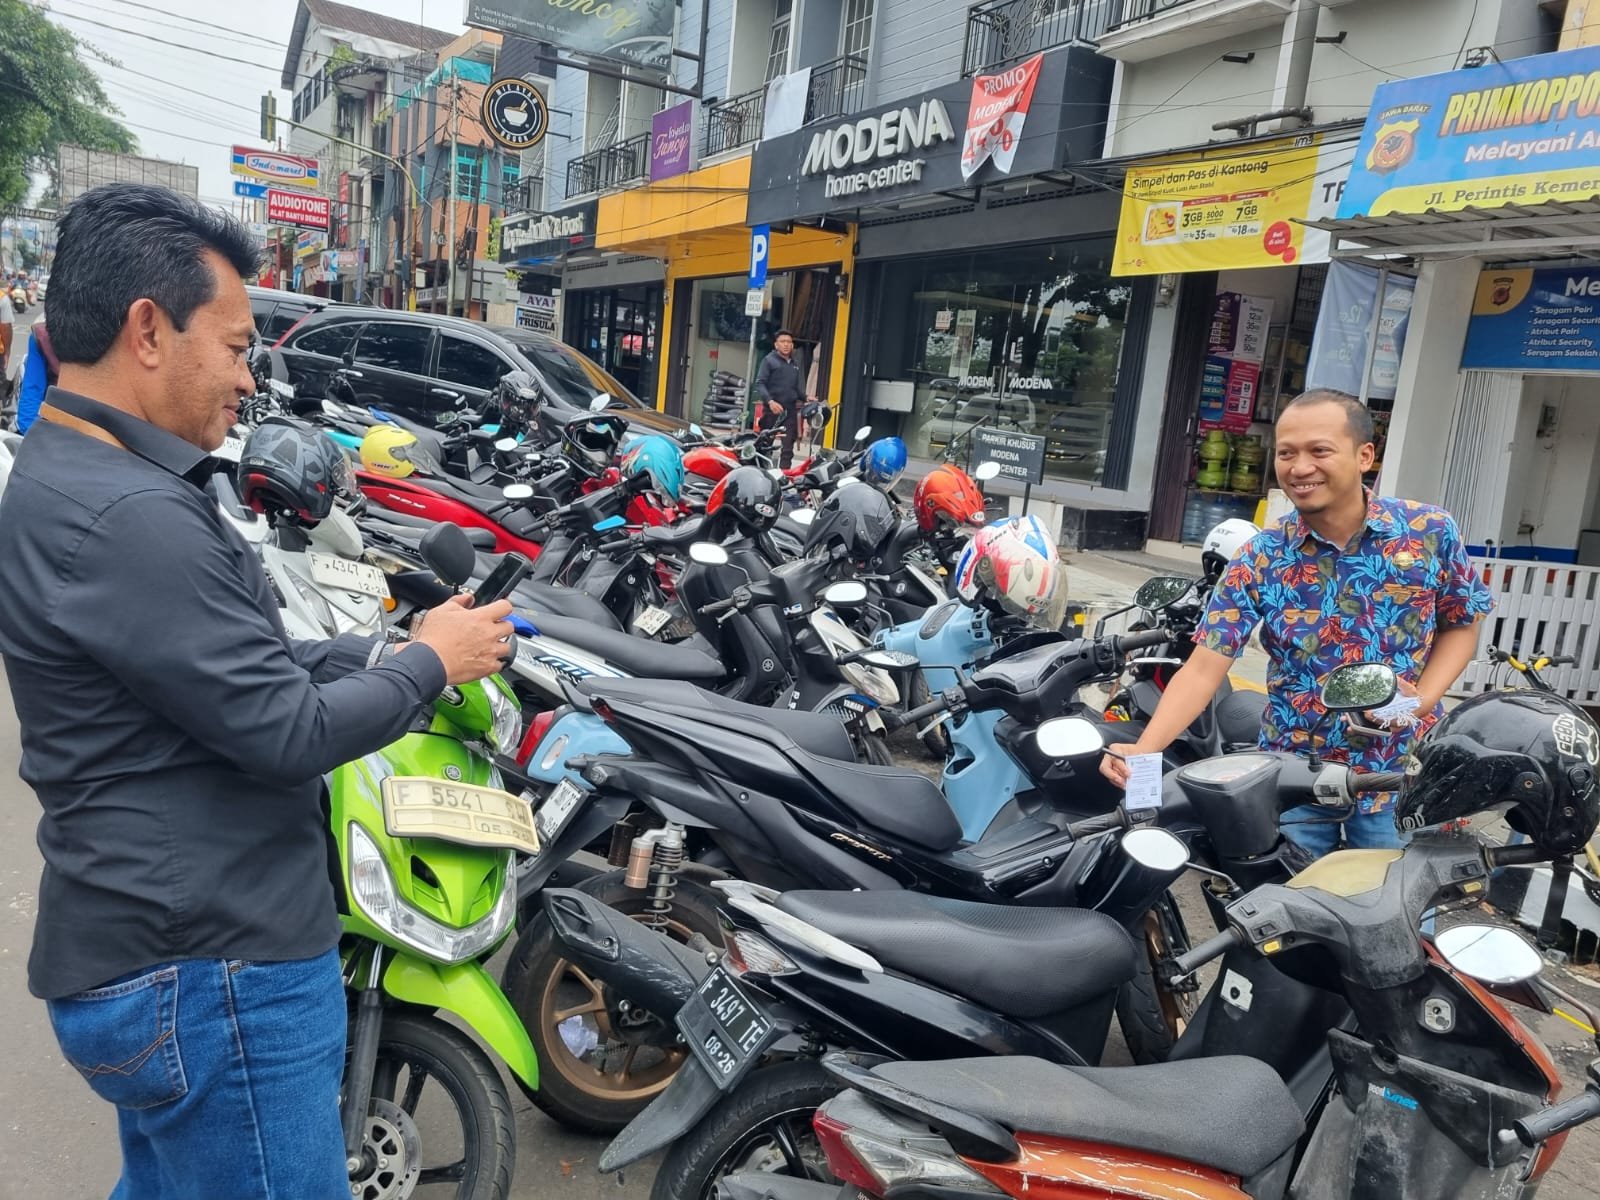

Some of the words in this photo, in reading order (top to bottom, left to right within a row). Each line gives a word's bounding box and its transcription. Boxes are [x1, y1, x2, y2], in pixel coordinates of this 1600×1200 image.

[983, 68, 1026, 97] PROMO
[1381, 108, 1402, 120] JAWA
[1402, 105, 1429, 114] BARAT
[1440, 71, 1600, 137] PRIMKOPPO
[801, 98, 955, 177] MODENA
[1463, 130, 1577, 164] Melayani
[250, 158, 303, 175] Indomaret
[1132, 173, 1166, 189] Simpel
[1166, 172, 1186, 184] dan
[1187, 169, 1207, 180] Pas
[1208, 166, 1219, 178] di
[1220, 160, 1269, 175] Kantong
[825, 171, 868, 199] home
[867, 158, 926, 189] center
[1425, 191, 1446, 206] Jl.
[1454, 182, 1527, 203] Perintis
[269, 208, 286, 218] ALAT
[270, 194, 328, 215] AUDIOTONE
[751, 234, 768, 278] P
[1535, 306, 1573, 317] Seragam
[1573, 305, 1593, 314] Polri
[519, 316, 556, 331] TRISULA
[1533, 317, 1570, 327] Seragam
[1560, 328, 1580, 336] Polri
[1528, 338, 1557, 346] Atribut
[1558, 337, 1593, 349] Security
[1526, 349, 1564, 358] Seragam
[1564, 348, 1598, 357] Sekolah
[1009, 377, 1053, 390] MODENA
[981, 433, 1007, 447] PARKIR
[1006, 438, 1037, 451] KHUSUS
[989, 448, 1020, 462] MODENA
[1000, 463, 1028, 477] CENTER
[700, 973, 719, 994] F
[709, 987, 748, 1028] 3497
[738, 1019, 766, 1053] TE
